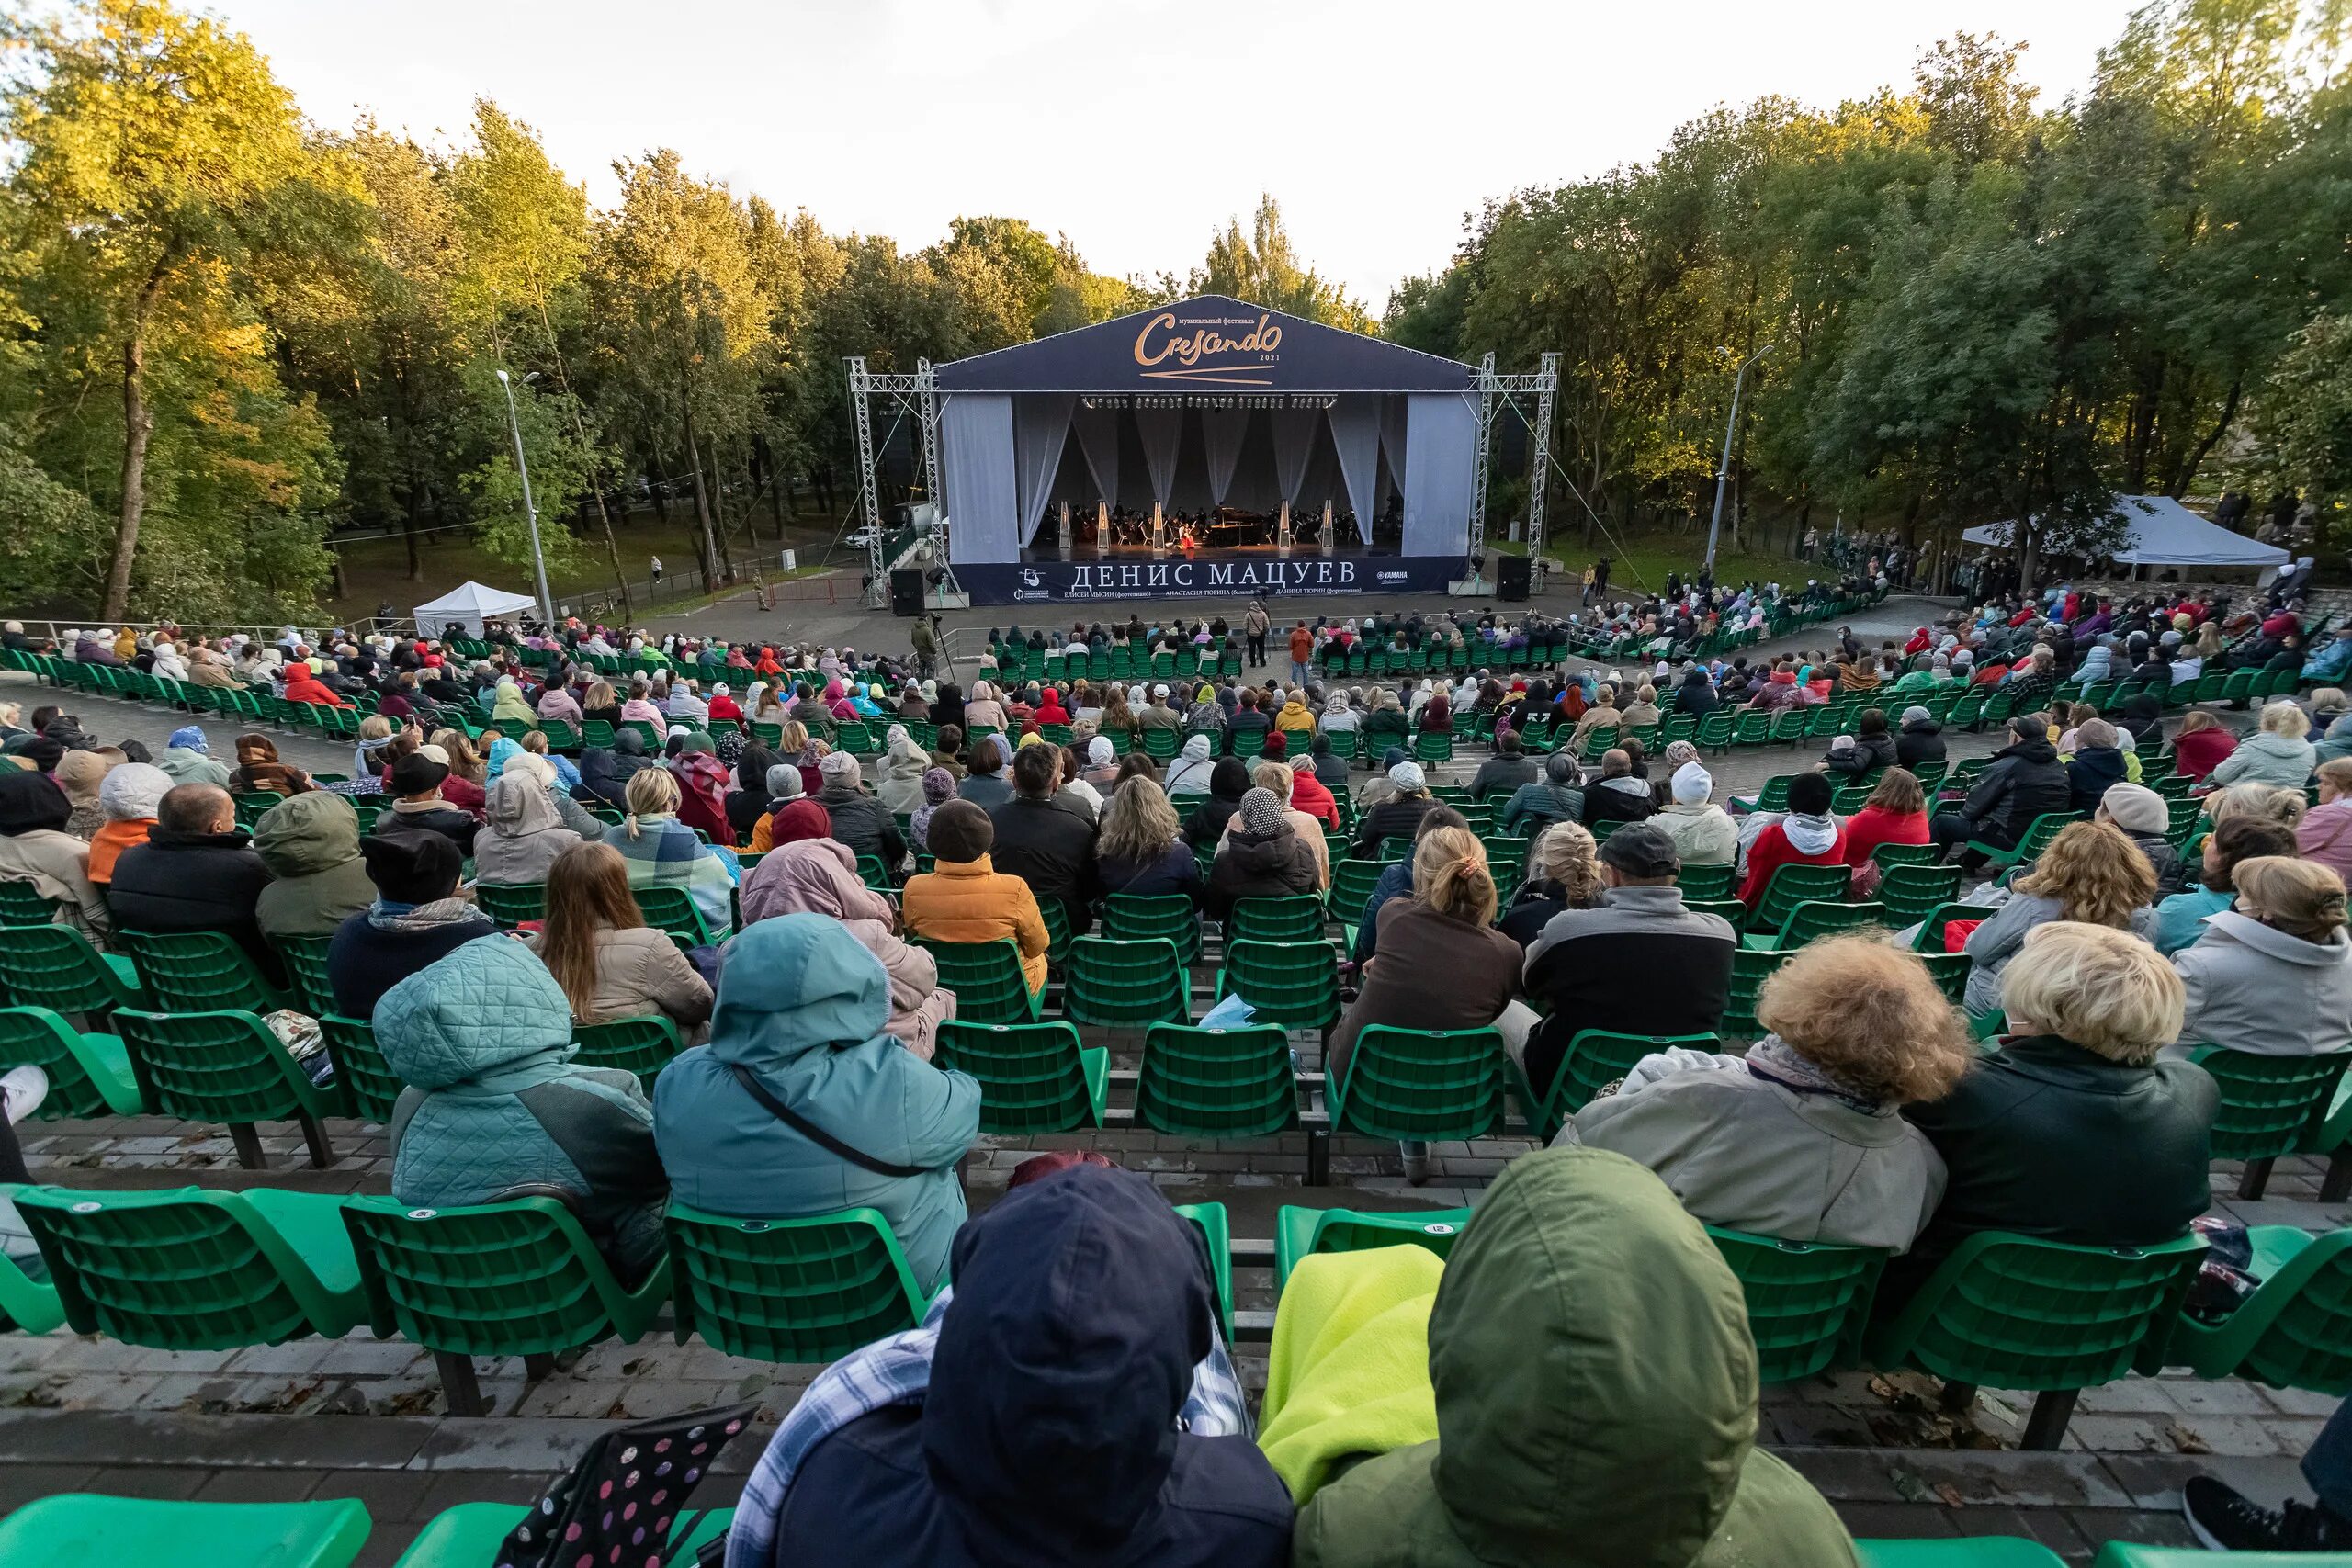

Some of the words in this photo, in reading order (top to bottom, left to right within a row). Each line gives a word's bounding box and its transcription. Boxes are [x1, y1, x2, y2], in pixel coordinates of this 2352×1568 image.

[1222, 317, 1255, 326] фестиваль
[1134, 312, 1283, 366] Crescendo
[1071, 564, 1193, 592] ДЕНИС
[1208, 561, 1355, 589] МАЦУЕВ
